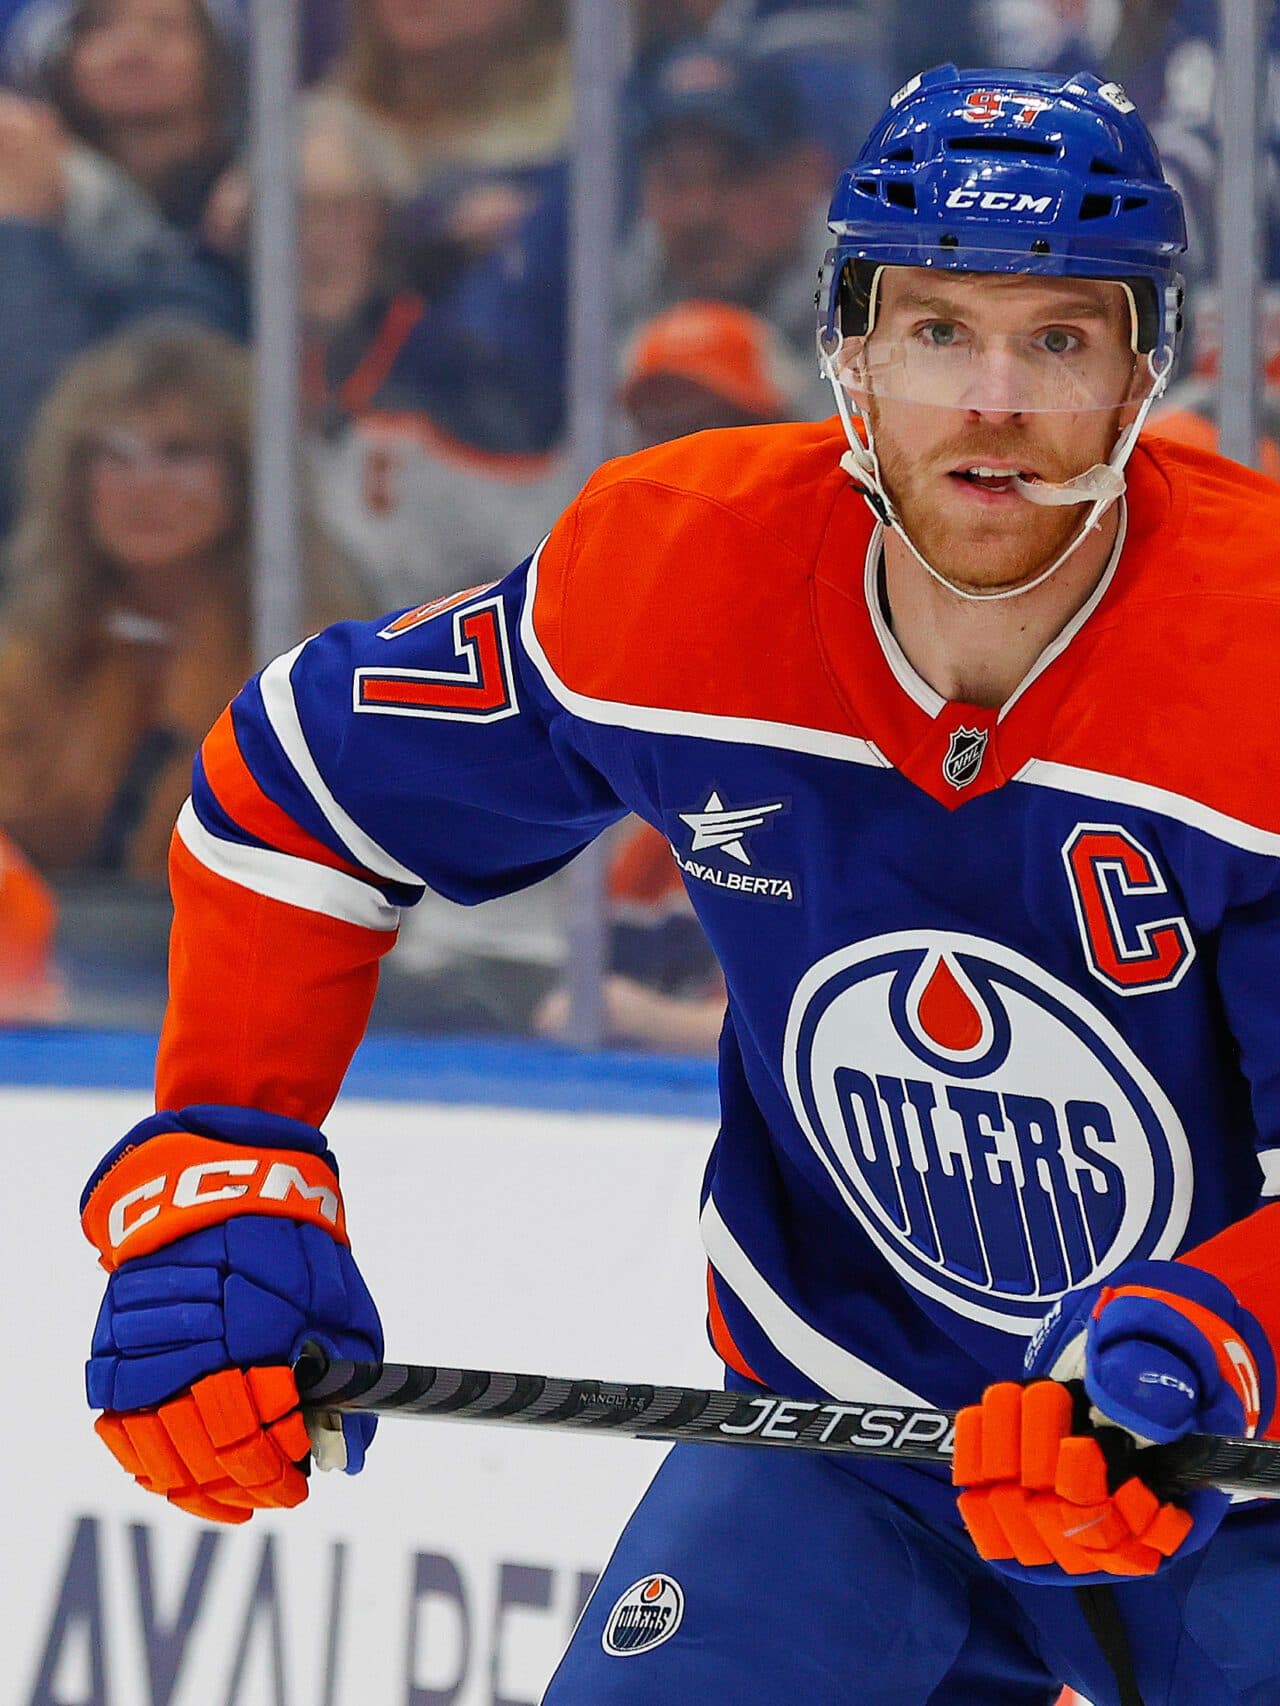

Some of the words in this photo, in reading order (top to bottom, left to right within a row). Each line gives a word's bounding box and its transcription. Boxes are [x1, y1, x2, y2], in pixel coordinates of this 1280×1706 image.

[963, 91, 1053, 126] 97
[946, 189, 1052, 215] CCM
[353, 580, 521, 724] 7
[952, 745, 979, 774] NHL
[1061, 822, 1197, 997] C
[108, 1159, 340, 1249] CCM
[834, 1066, 1127, 1296] OILERS
[613, 1605, 672, 1646] OILERS
